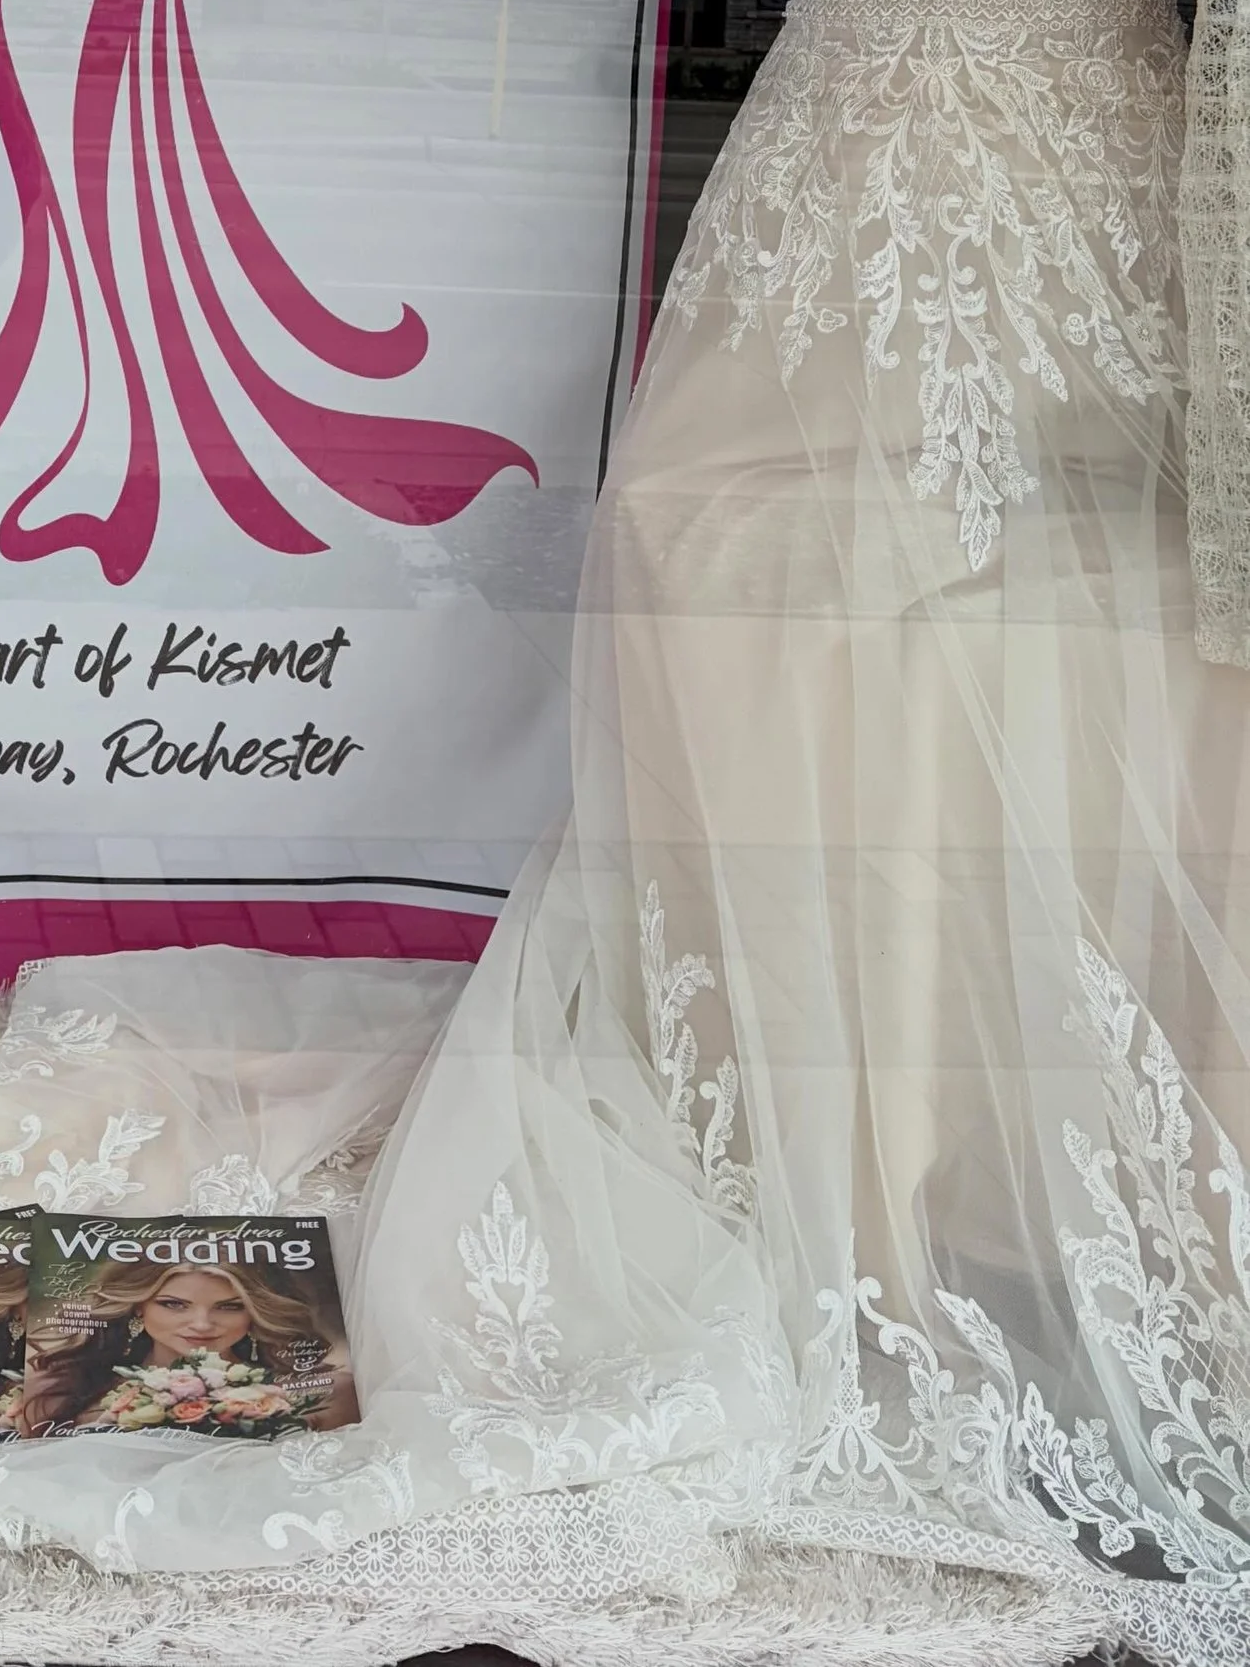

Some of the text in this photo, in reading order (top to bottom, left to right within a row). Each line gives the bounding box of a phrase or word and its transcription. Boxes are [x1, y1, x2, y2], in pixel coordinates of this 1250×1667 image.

[74, 622, 133, 698] of
[146, 622, 351, 690] Kismet
[102, 718, 365, 784] Rochester
[79, 1220, 288, 1241] Rochester Area
[295, 1221, 320, 1229] FREE
[51, 1228, 315, 1271] Wedding
[62, 1302, 92, 1311] venues
[63, 1310, 91, 1319] gowns
[46, 1317, 108, 1328] photographers
[58, 1325, 95, 1336] catering
[282, 1378, 332, 1390] BACKYARD
